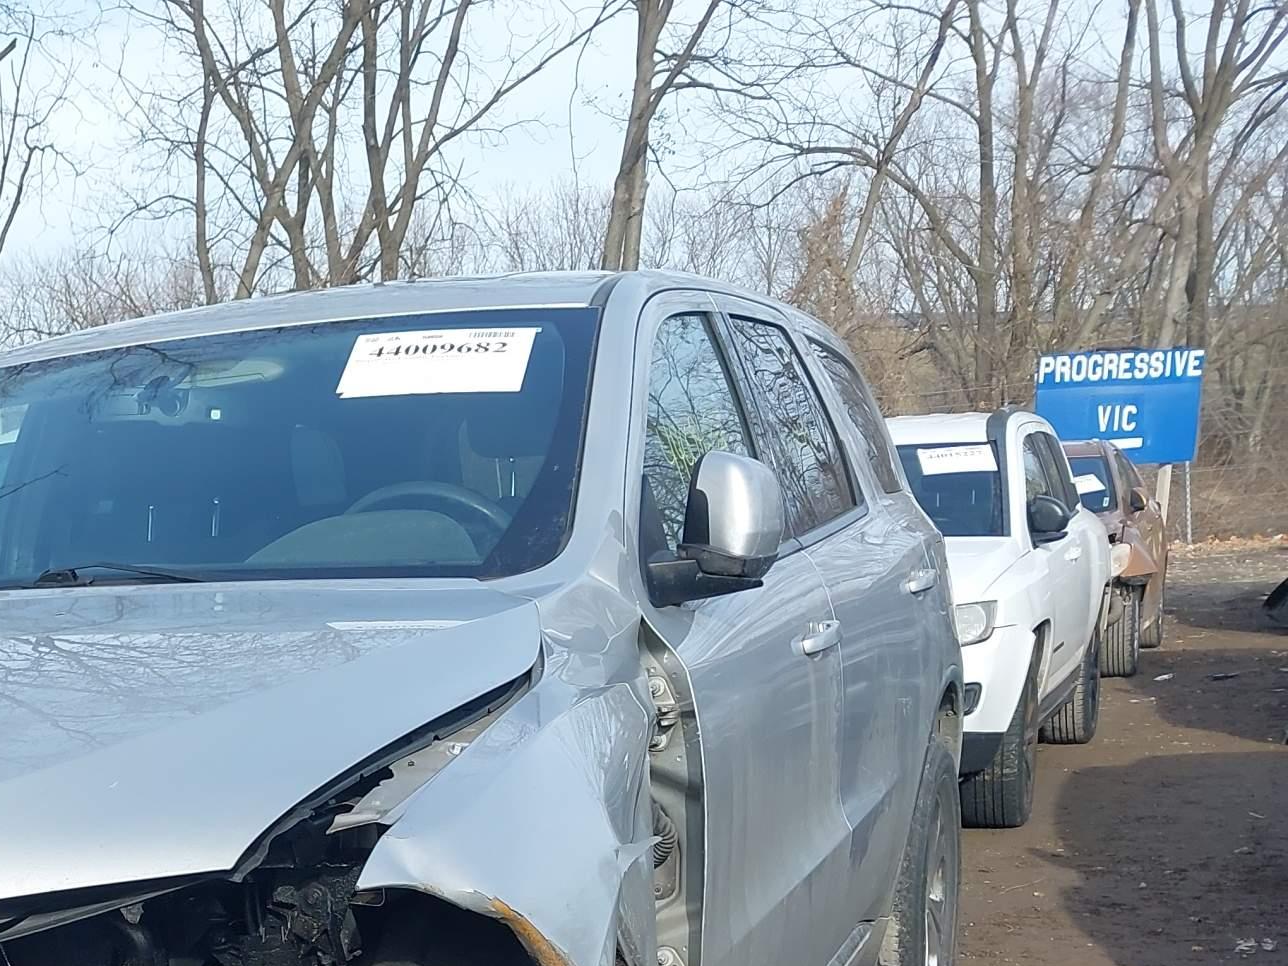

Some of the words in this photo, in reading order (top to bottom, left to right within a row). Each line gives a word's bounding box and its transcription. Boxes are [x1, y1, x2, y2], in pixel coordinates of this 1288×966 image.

[369, 341, 508, 357] 44009682
[1038, 350, 1205, 384] PROGRESSIVE
[1098, 405, 1138, 432] VIC
